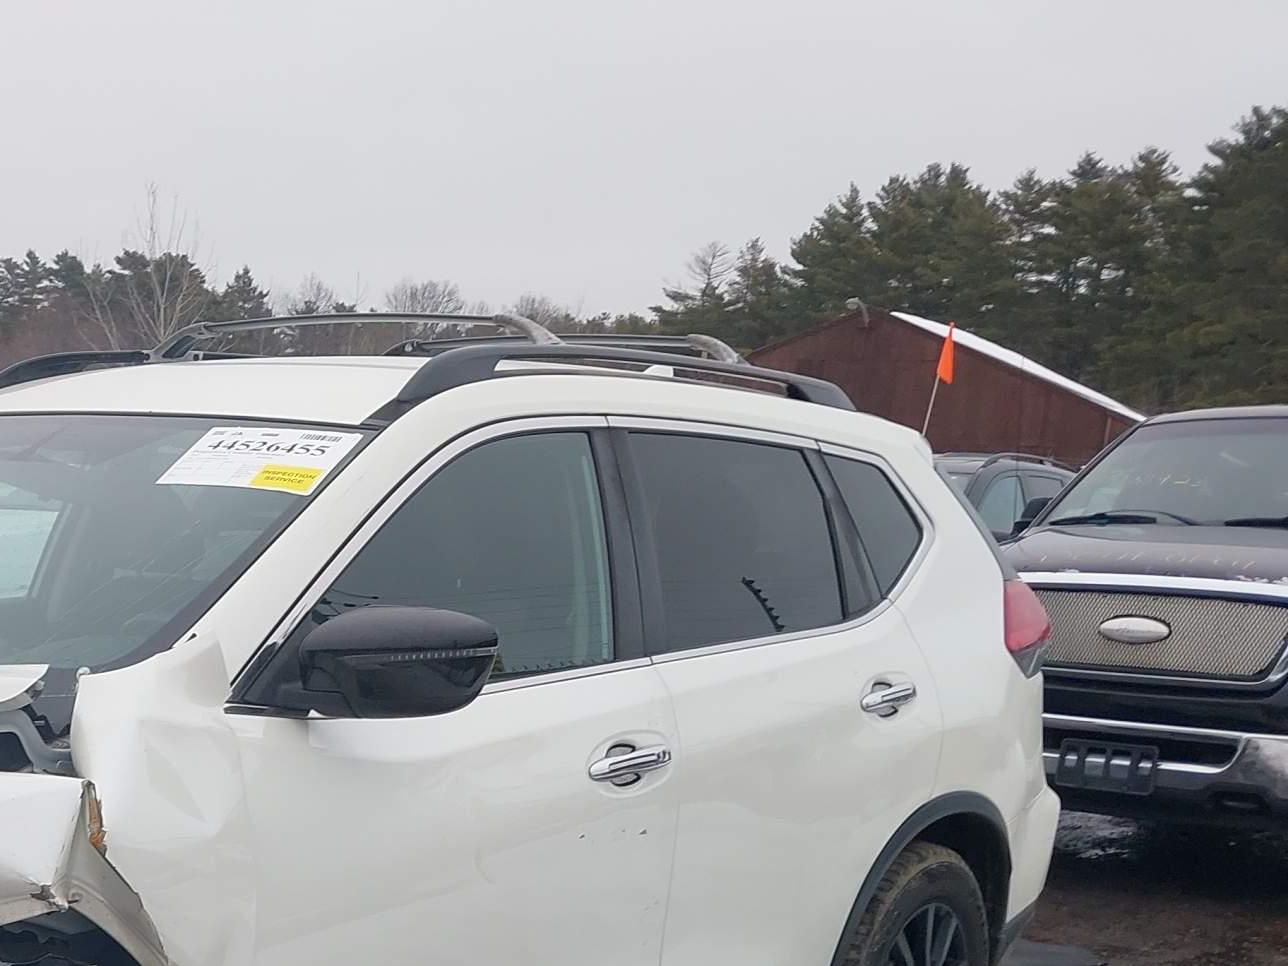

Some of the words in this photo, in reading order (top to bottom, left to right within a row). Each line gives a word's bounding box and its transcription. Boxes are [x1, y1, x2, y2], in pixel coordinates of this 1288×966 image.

[207, 439, 331, 457] 44526455
[262, 470, 318, 480] INSPECTION
[264, 475, 305, 484] SERVICE
